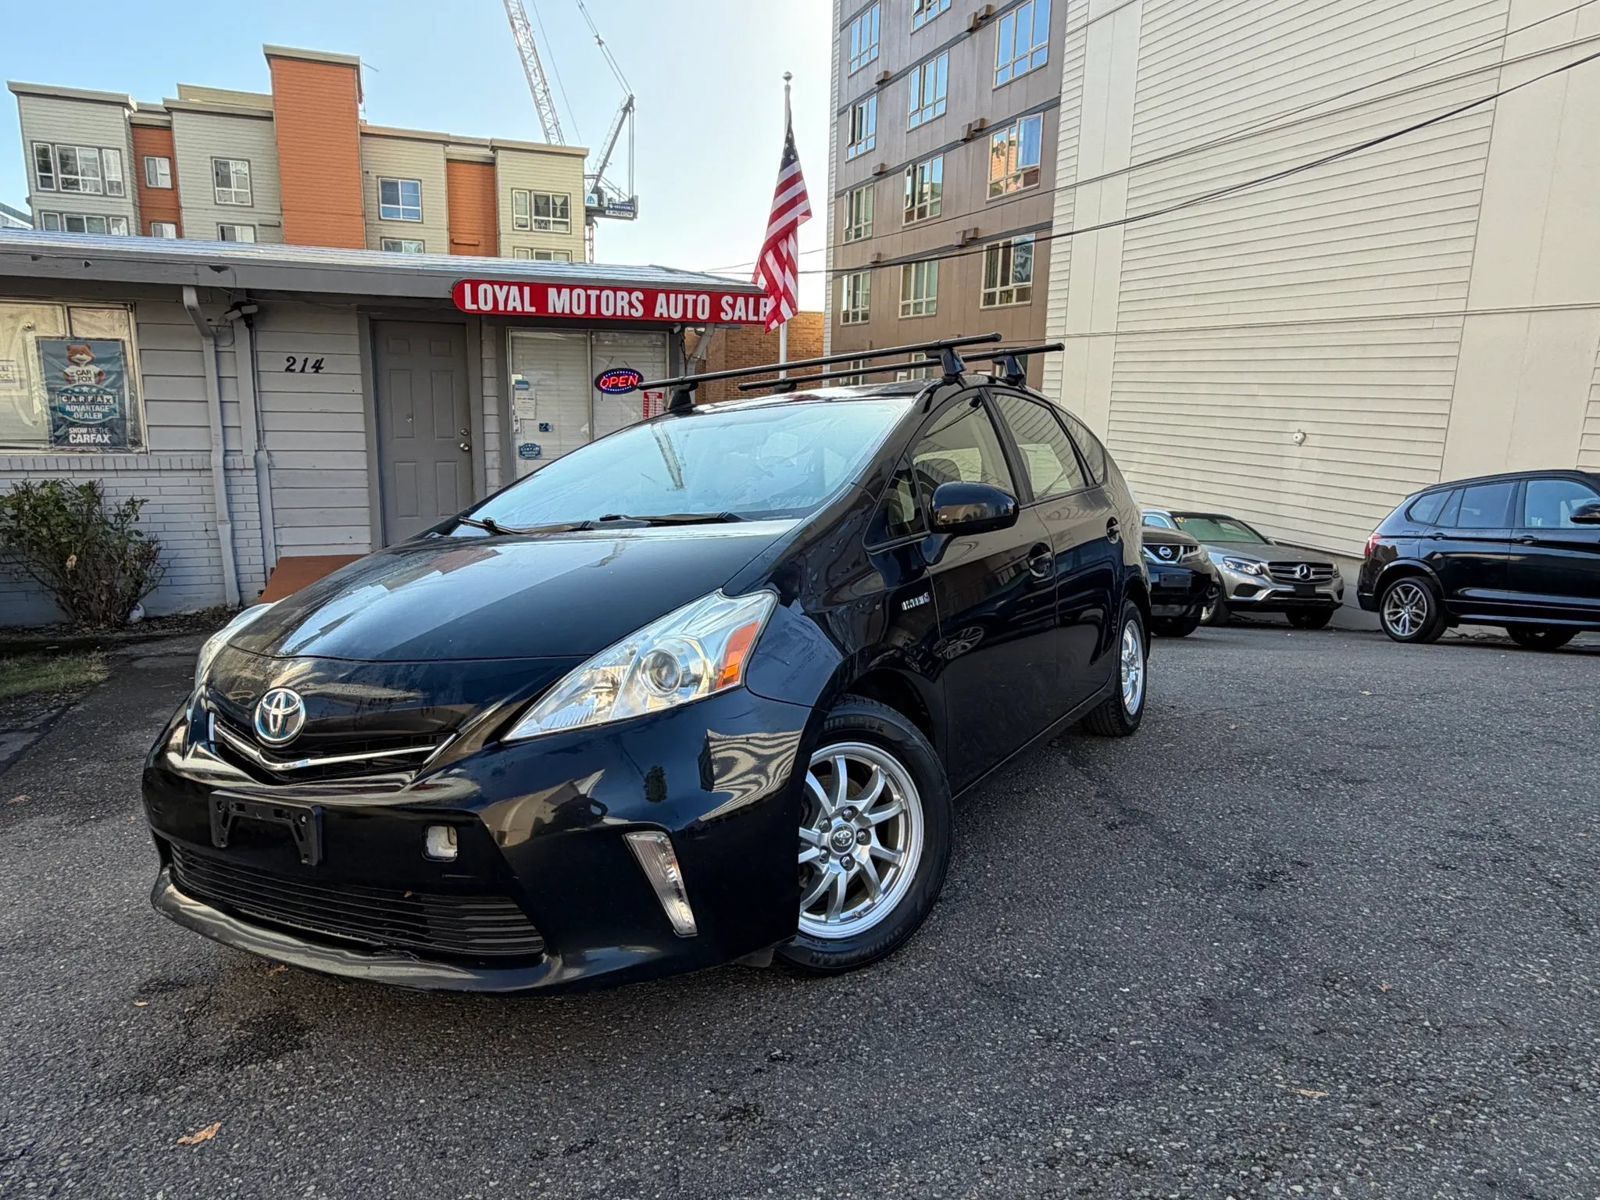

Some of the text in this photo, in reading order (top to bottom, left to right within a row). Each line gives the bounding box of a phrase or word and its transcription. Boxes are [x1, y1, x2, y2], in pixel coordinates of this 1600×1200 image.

[464, 283, 536, 313] LOYAL
[547, 287, 644, 317] MOTORS
[654, 293, 710, 320] AUTO
[285, 355, 325, 373] 214
[600, 375, 639, 388] OPEN
[61, 394, 113, 404] CARFAX
[69, 434, 110, 444] CARFAX
